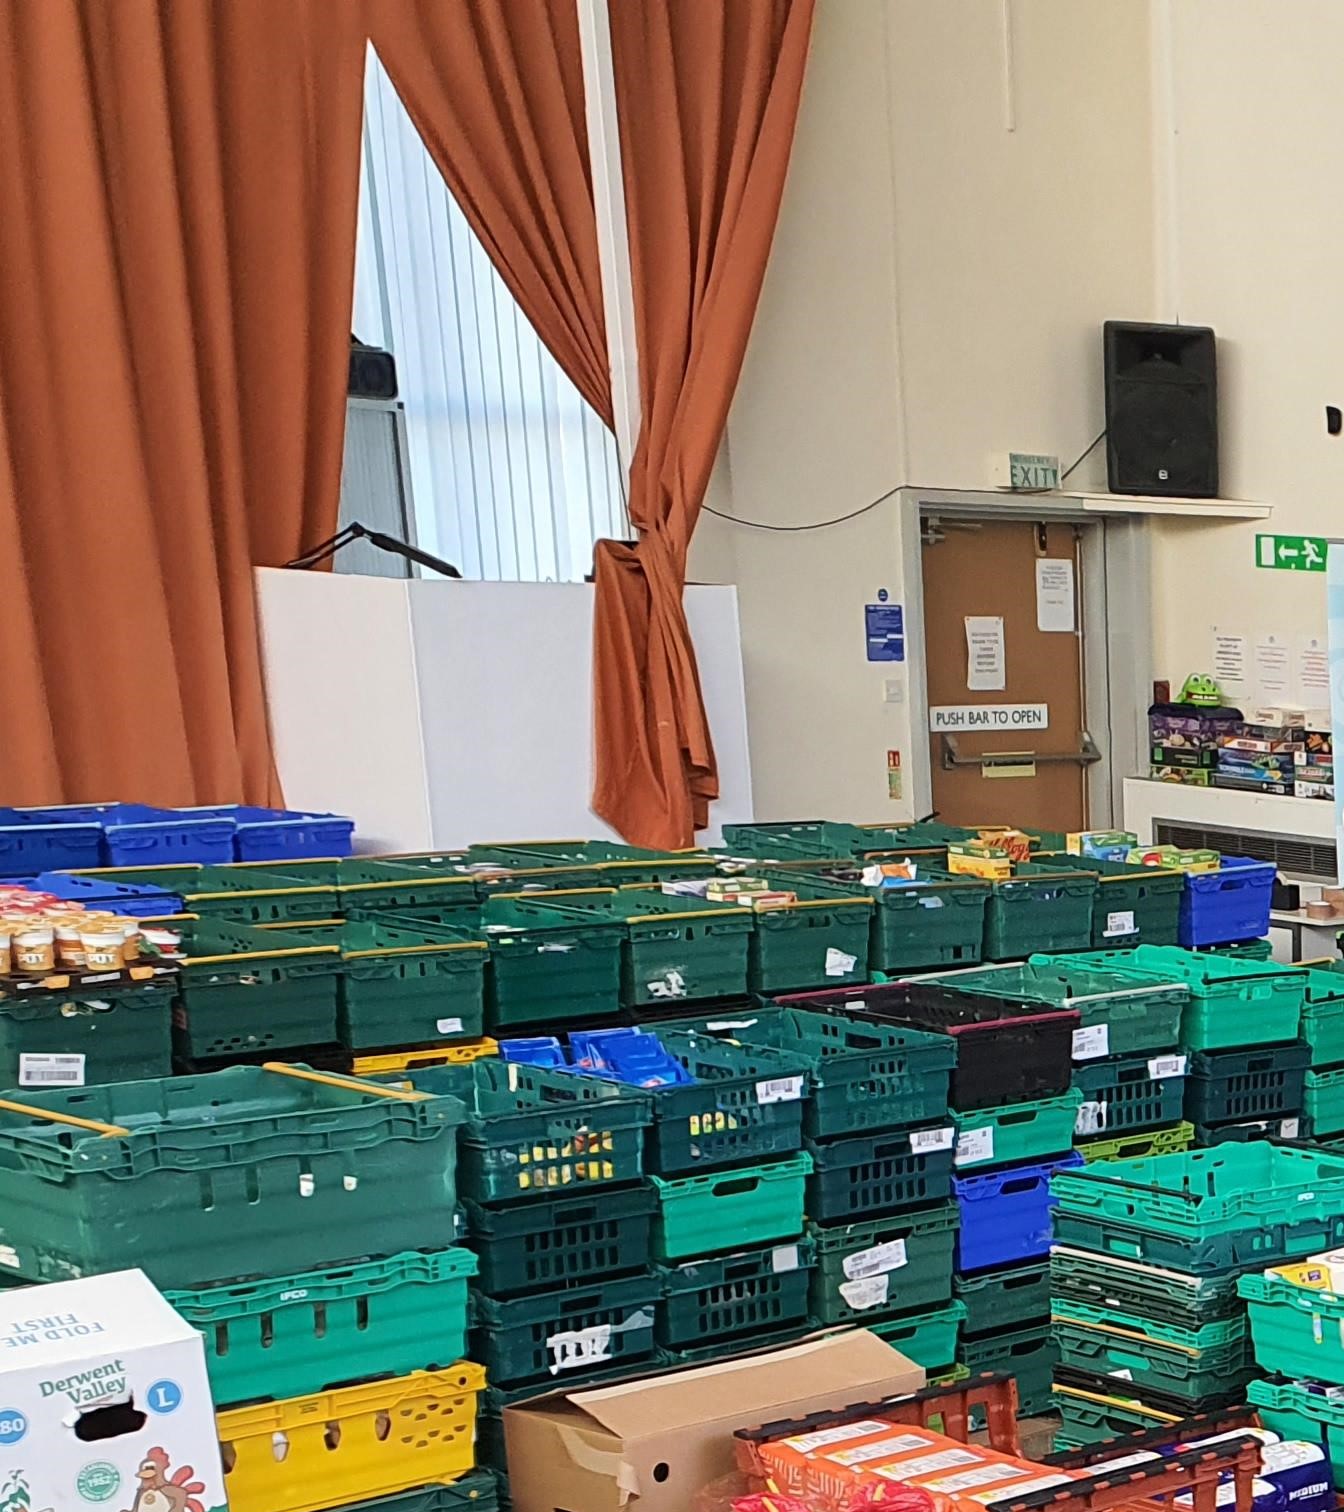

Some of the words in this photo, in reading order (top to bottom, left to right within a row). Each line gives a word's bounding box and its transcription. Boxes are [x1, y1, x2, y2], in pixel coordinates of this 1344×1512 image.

[1011, 464, 1049, 488] EXIT
[936, 712, 964, 725] PUSH
[969, 711, 990, 724] BAR
[993, 711, 1008, 723] TO
[1012, 710, 1041, 723] OPEN
[280, 1290, 307, 1299] IFCO
[11, 1313, 79, 1334] FIRST
[44, 1321, 105, 1341] FOLD
[1, 1333, 38, 1349] ME
[39, 1360, 126, 1398] Derwent
[66, 1377, 127, 1405] Valley
[155, 1387, 175, 1408] L
[1289, 1482, 1328, 1500] MEDIUM
